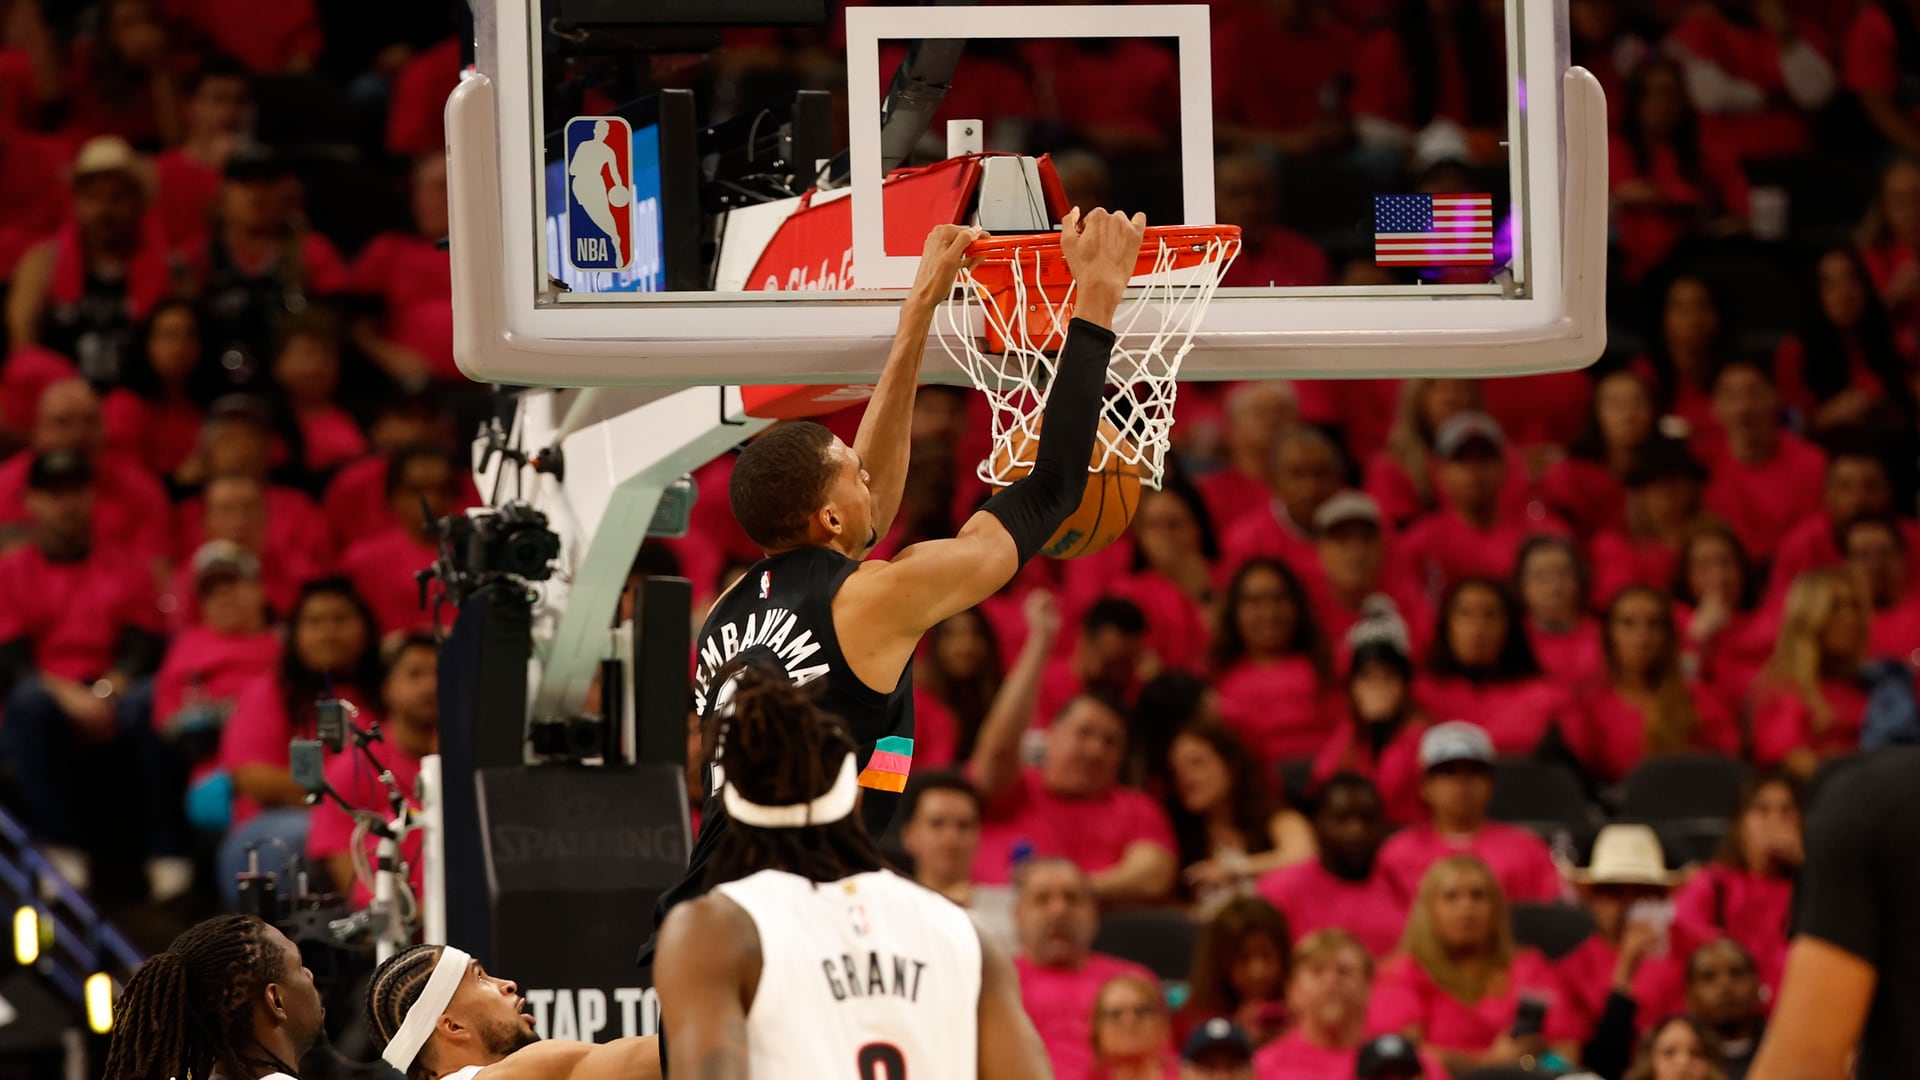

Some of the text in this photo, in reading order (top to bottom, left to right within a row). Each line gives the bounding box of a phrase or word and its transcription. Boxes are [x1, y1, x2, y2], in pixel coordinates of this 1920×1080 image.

[577, 238, 608, 261] NBA
[494, 824, 683, 864] SPALDING
[822, 951, 927, 1003] GRANT
[526, 988, 607, 1043] TAP
